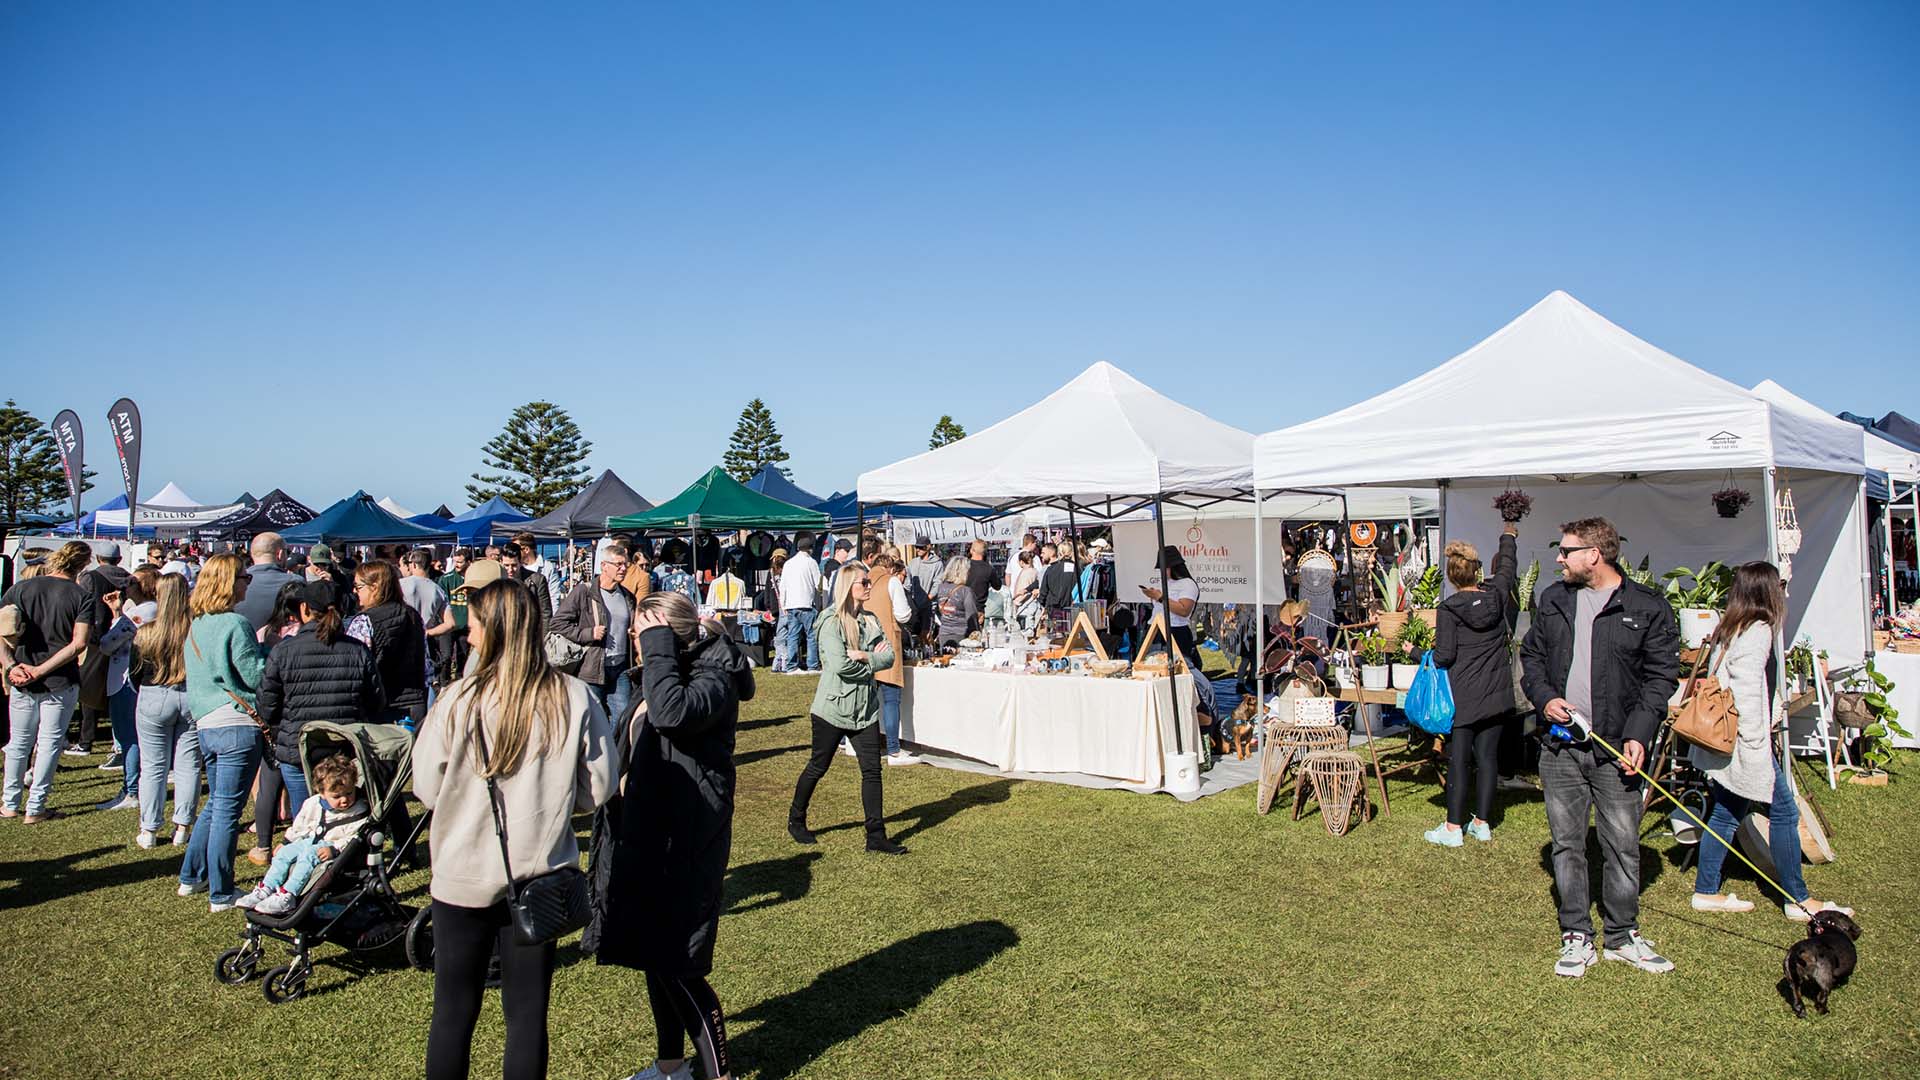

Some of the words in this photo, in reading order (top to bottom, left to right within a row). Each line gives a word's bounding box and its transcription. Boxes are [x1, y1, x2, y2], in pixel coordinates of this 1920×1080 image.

[117, 411, 135, 445] ATM
[143, 511, 196, 519] STELLINO
[913, 520, 946, 540] WOLF
[953, 520, 969, 538] and
[1196, 576, 1248, 585] BOMBONIERE
